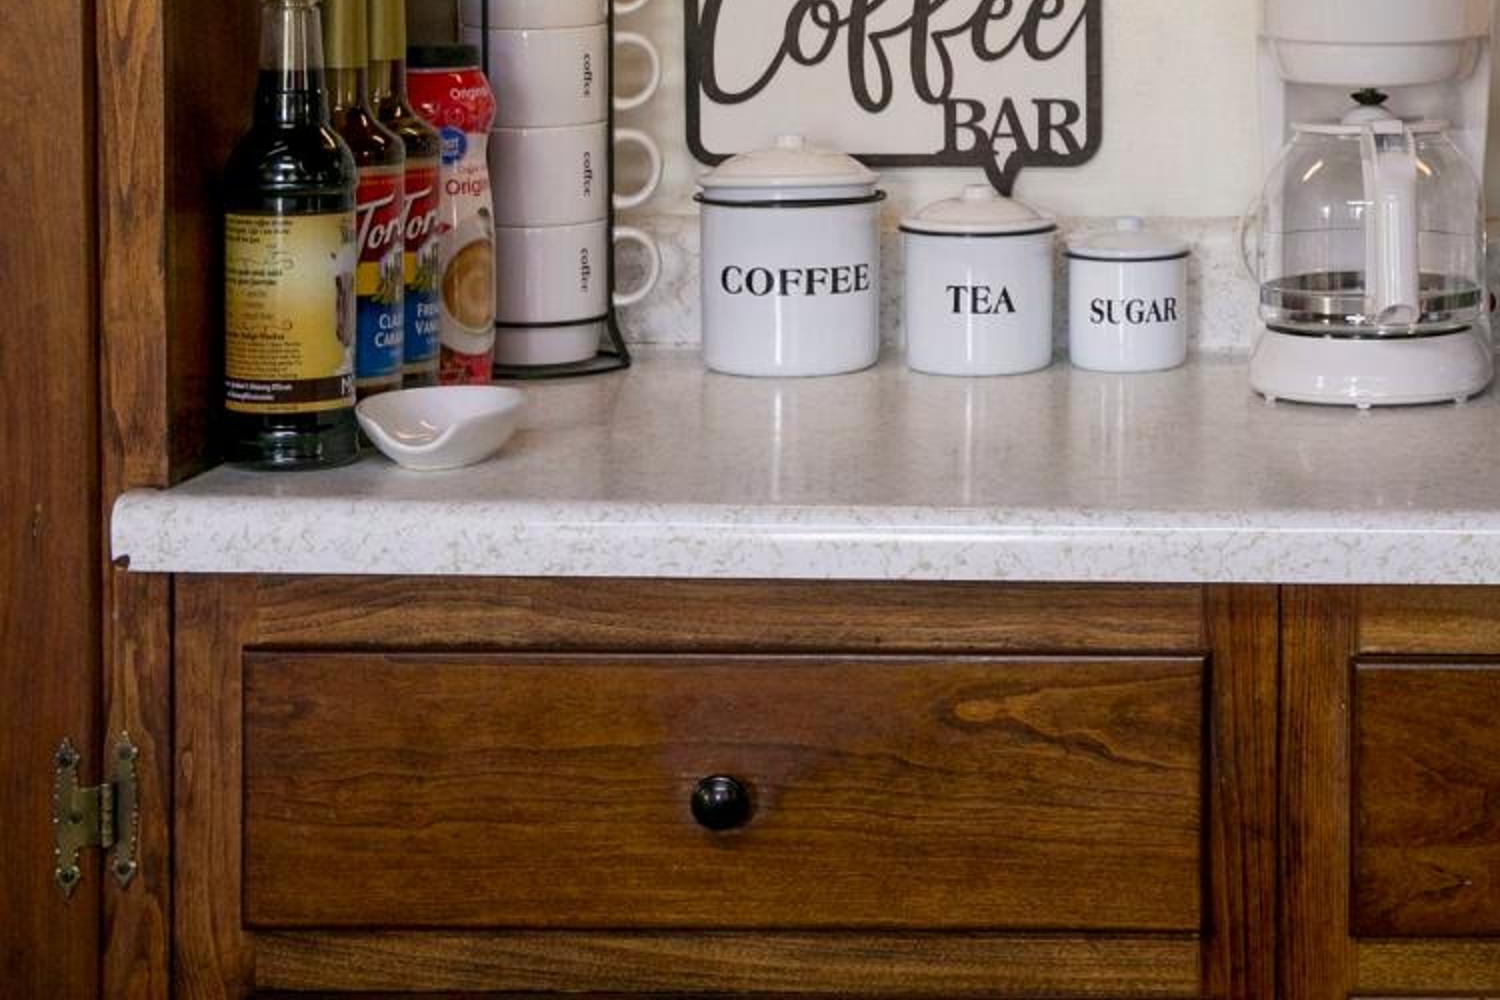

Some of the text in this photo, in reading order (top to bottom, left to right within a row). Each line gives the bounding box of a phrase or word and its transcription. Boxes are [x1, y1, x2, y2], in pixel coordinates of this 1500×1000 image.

[583, 53, 593, 97] coffee
[943, 97, 1083, 155] BAR
[583, 151, 593, 198] coffee
[580, 248, 591, 293] coffee
[720, 263, 870, 297] COFFEE
[946, 285, 1016, 315] TEA
[1089, 297, 1178, 325] SUGAR
